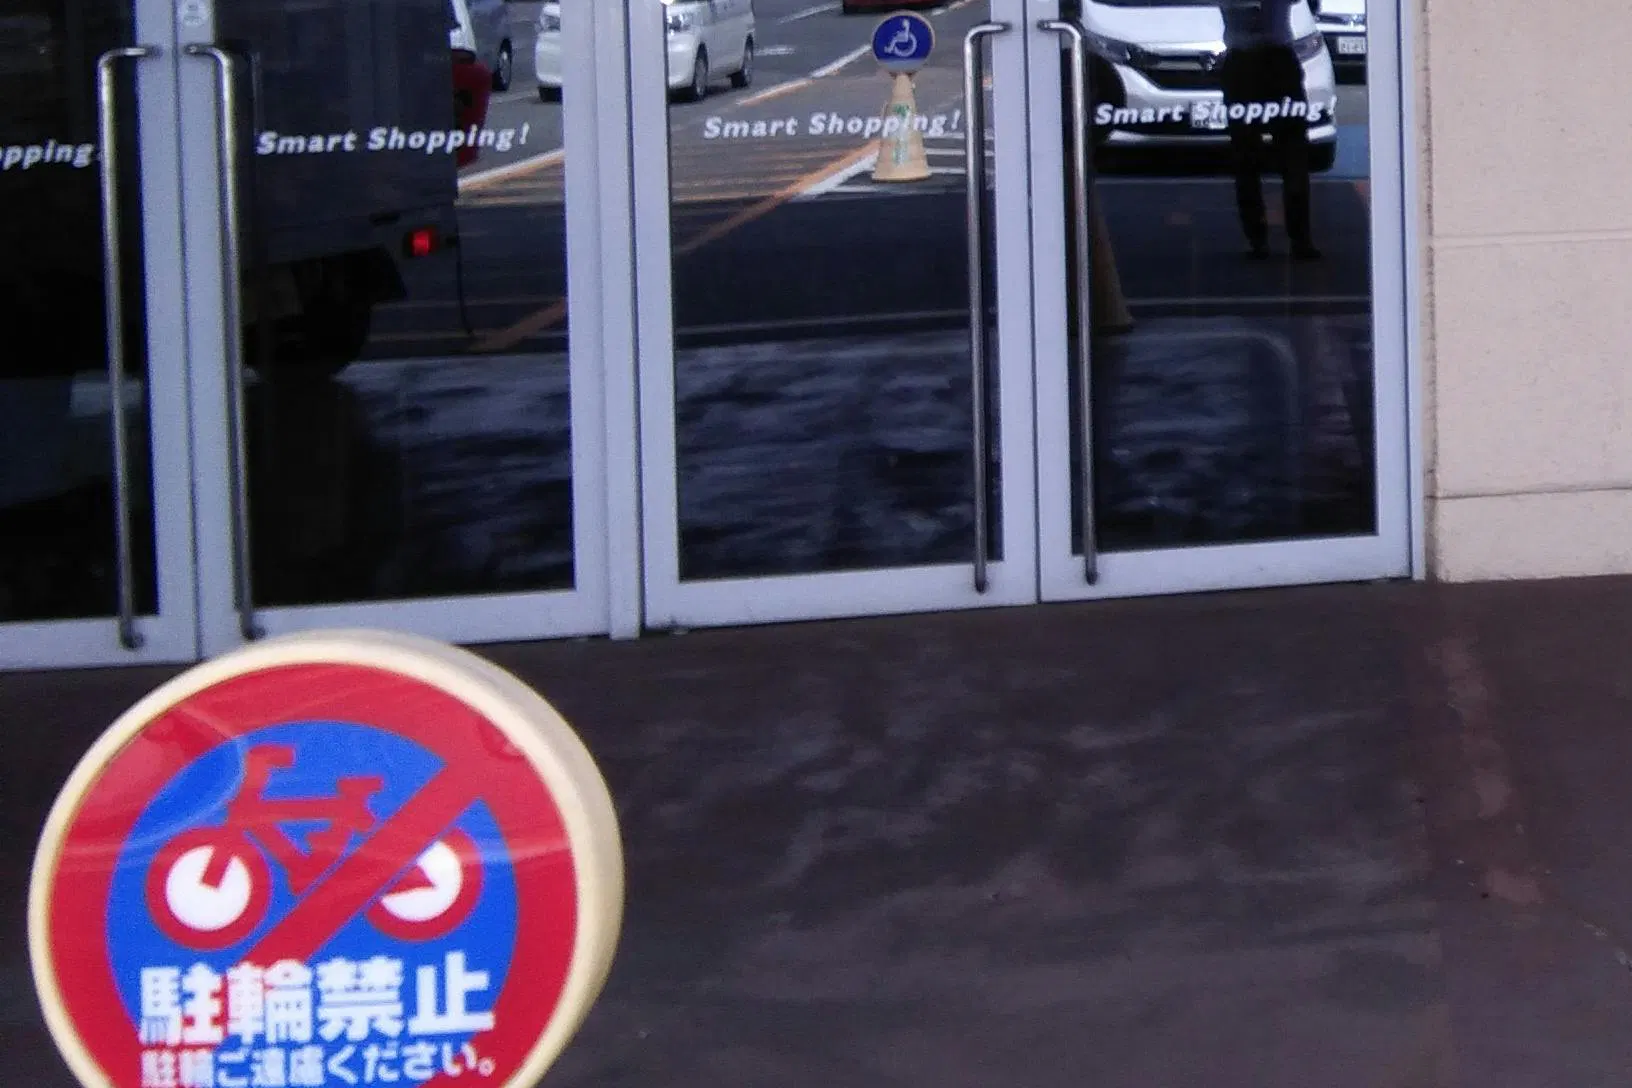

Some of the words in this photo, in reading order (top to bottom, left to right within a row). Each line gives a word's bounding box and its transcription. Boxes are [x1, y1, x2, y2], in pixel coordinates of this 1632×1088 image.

[703, 115, 800, 140] Smart
[807, 109, 962, 138] Shopping!
[1094, 102, 1185, 126] Smart
[1193, 95, 1338, 125] Shopping!
[255, 129, 358, 155] Smart
[366, 121, 530, 155] Shopping!
[138, 950, 496, 1047] 駐輪禁止
